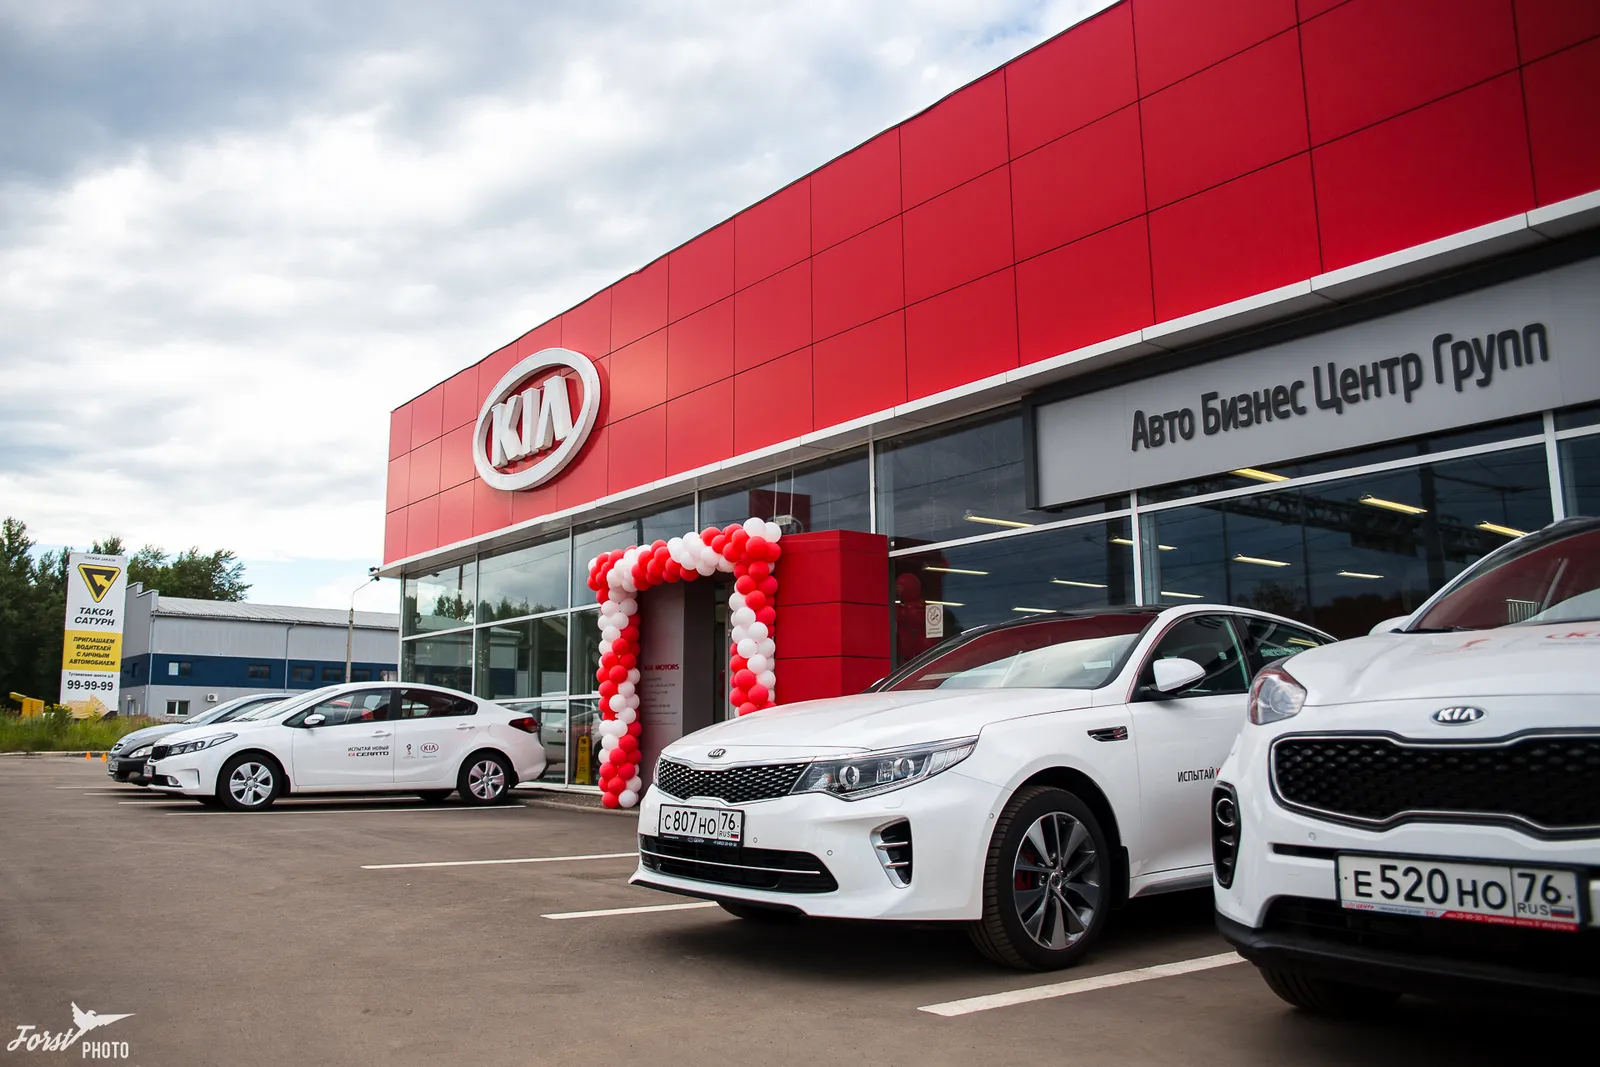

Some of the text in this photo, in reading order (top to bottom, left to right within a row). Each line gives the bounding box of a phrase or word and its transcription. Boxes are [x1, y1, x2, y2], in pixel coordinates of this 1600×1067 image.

[1131, 322, 1550, 452] Авто Бизнес Центр Групп
[491, 375, 574, 468] KIA
[79, 607, 113, 617] ТАКСИ
[74, 616, 115, 626] САТУРН
[73, 636, 115, 644] ПРИГЛАШАЕМ
[67, 679, 113, 691] 99-99-99
[1437, 707, 1477, 721] KIA
[1177, 767, 1214, 782] ИСПЫТАЙ
[721, 813, 736, 831] 76
[719, 830, 731, 838] RUS
[1517, 872, 1562, 905] 76
[1517, 902, 1549, 916] RUS
